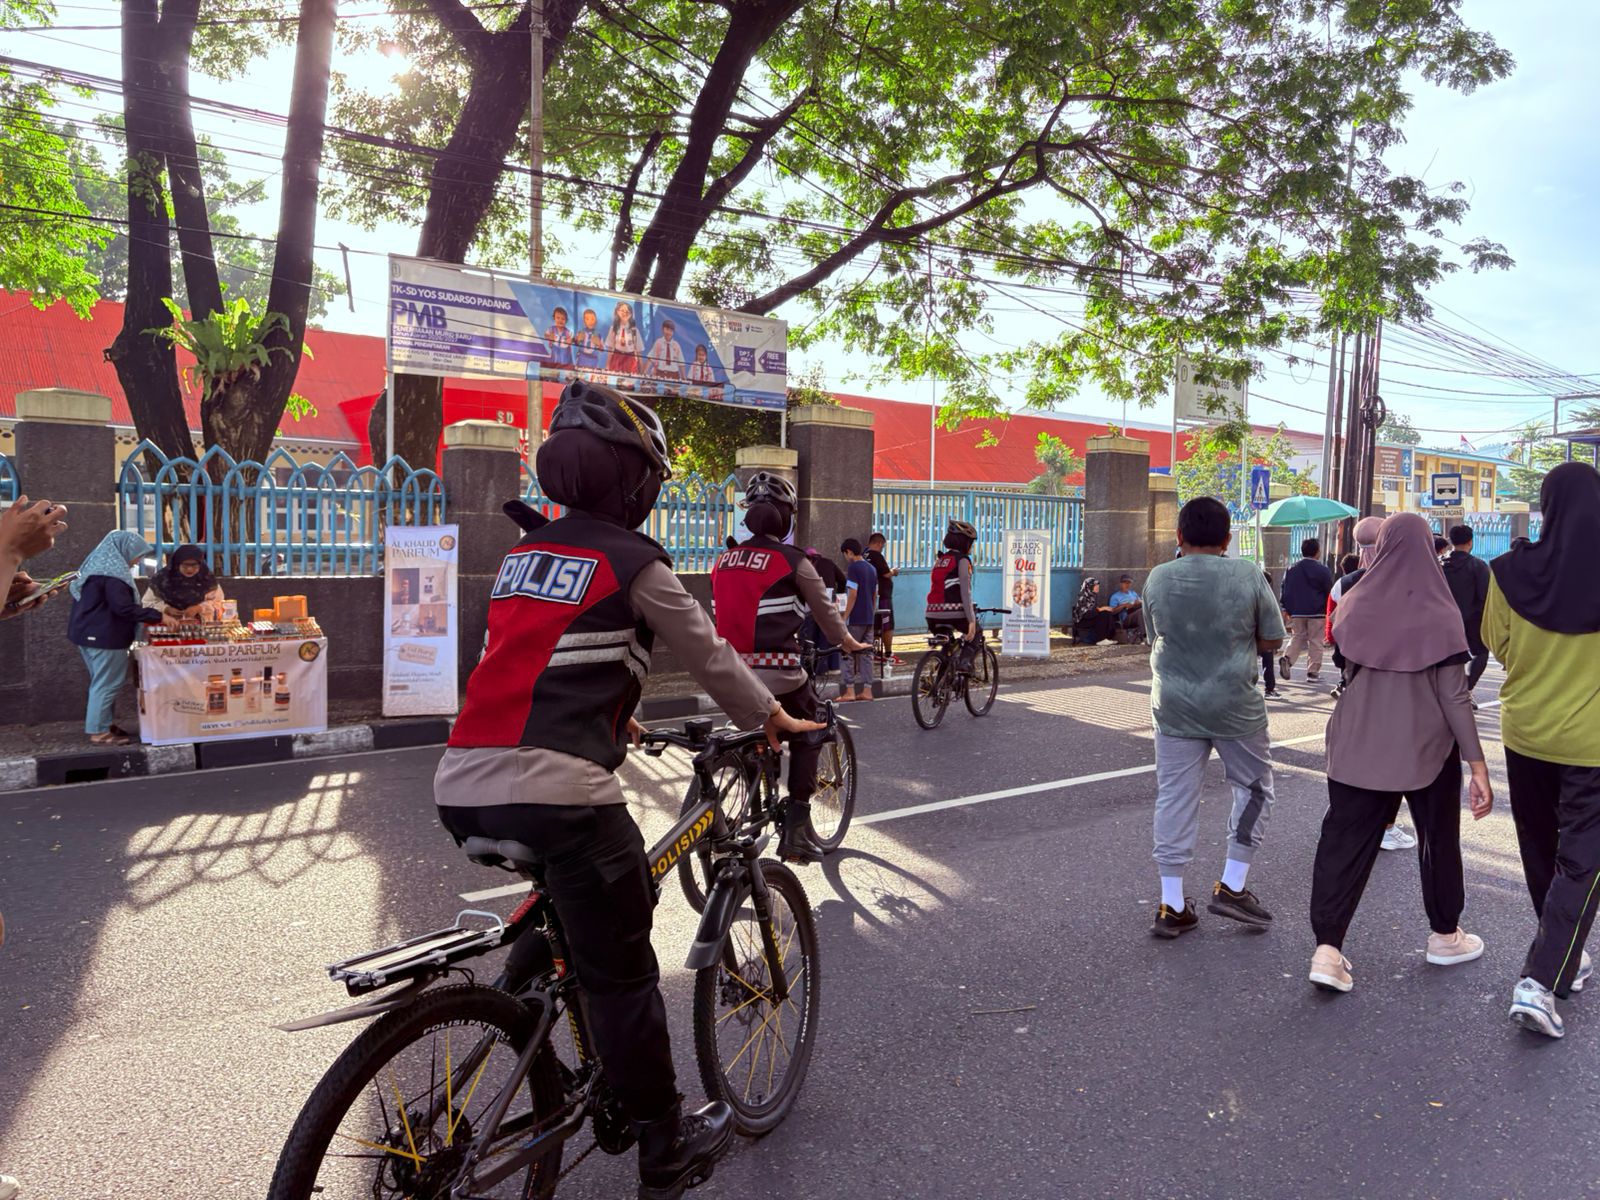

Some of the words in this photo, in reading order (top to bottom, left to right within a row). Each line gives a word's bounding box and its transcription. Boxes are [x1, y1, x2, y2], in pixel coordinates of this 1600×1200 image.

[392, 284, 417, 295] TK-SD
[418, 288, 437, 299] YOS
[438, 292, 476, 305] SUDARSO
[477, 298, 511, 310] PADANG
[392, 300, 448, 329] PMB
[497, 410, 514, 424] SD
[391, 540, 402, 548] AL
[404, 540, 436, 548] KHALID
[391, 547, 440, 558] PARFUM
[719, 550, 771, 570] POLISI
[494, 554, 591, 602] POLISI
[160, 647, 176, 658] AL
[179, 646, 226, 658] KHALID
[228, 643, 281, 657] PARFUM
[423, 1019, 465, 1036] POLISI
[467, 1020, 511, 1041] PATROLI
